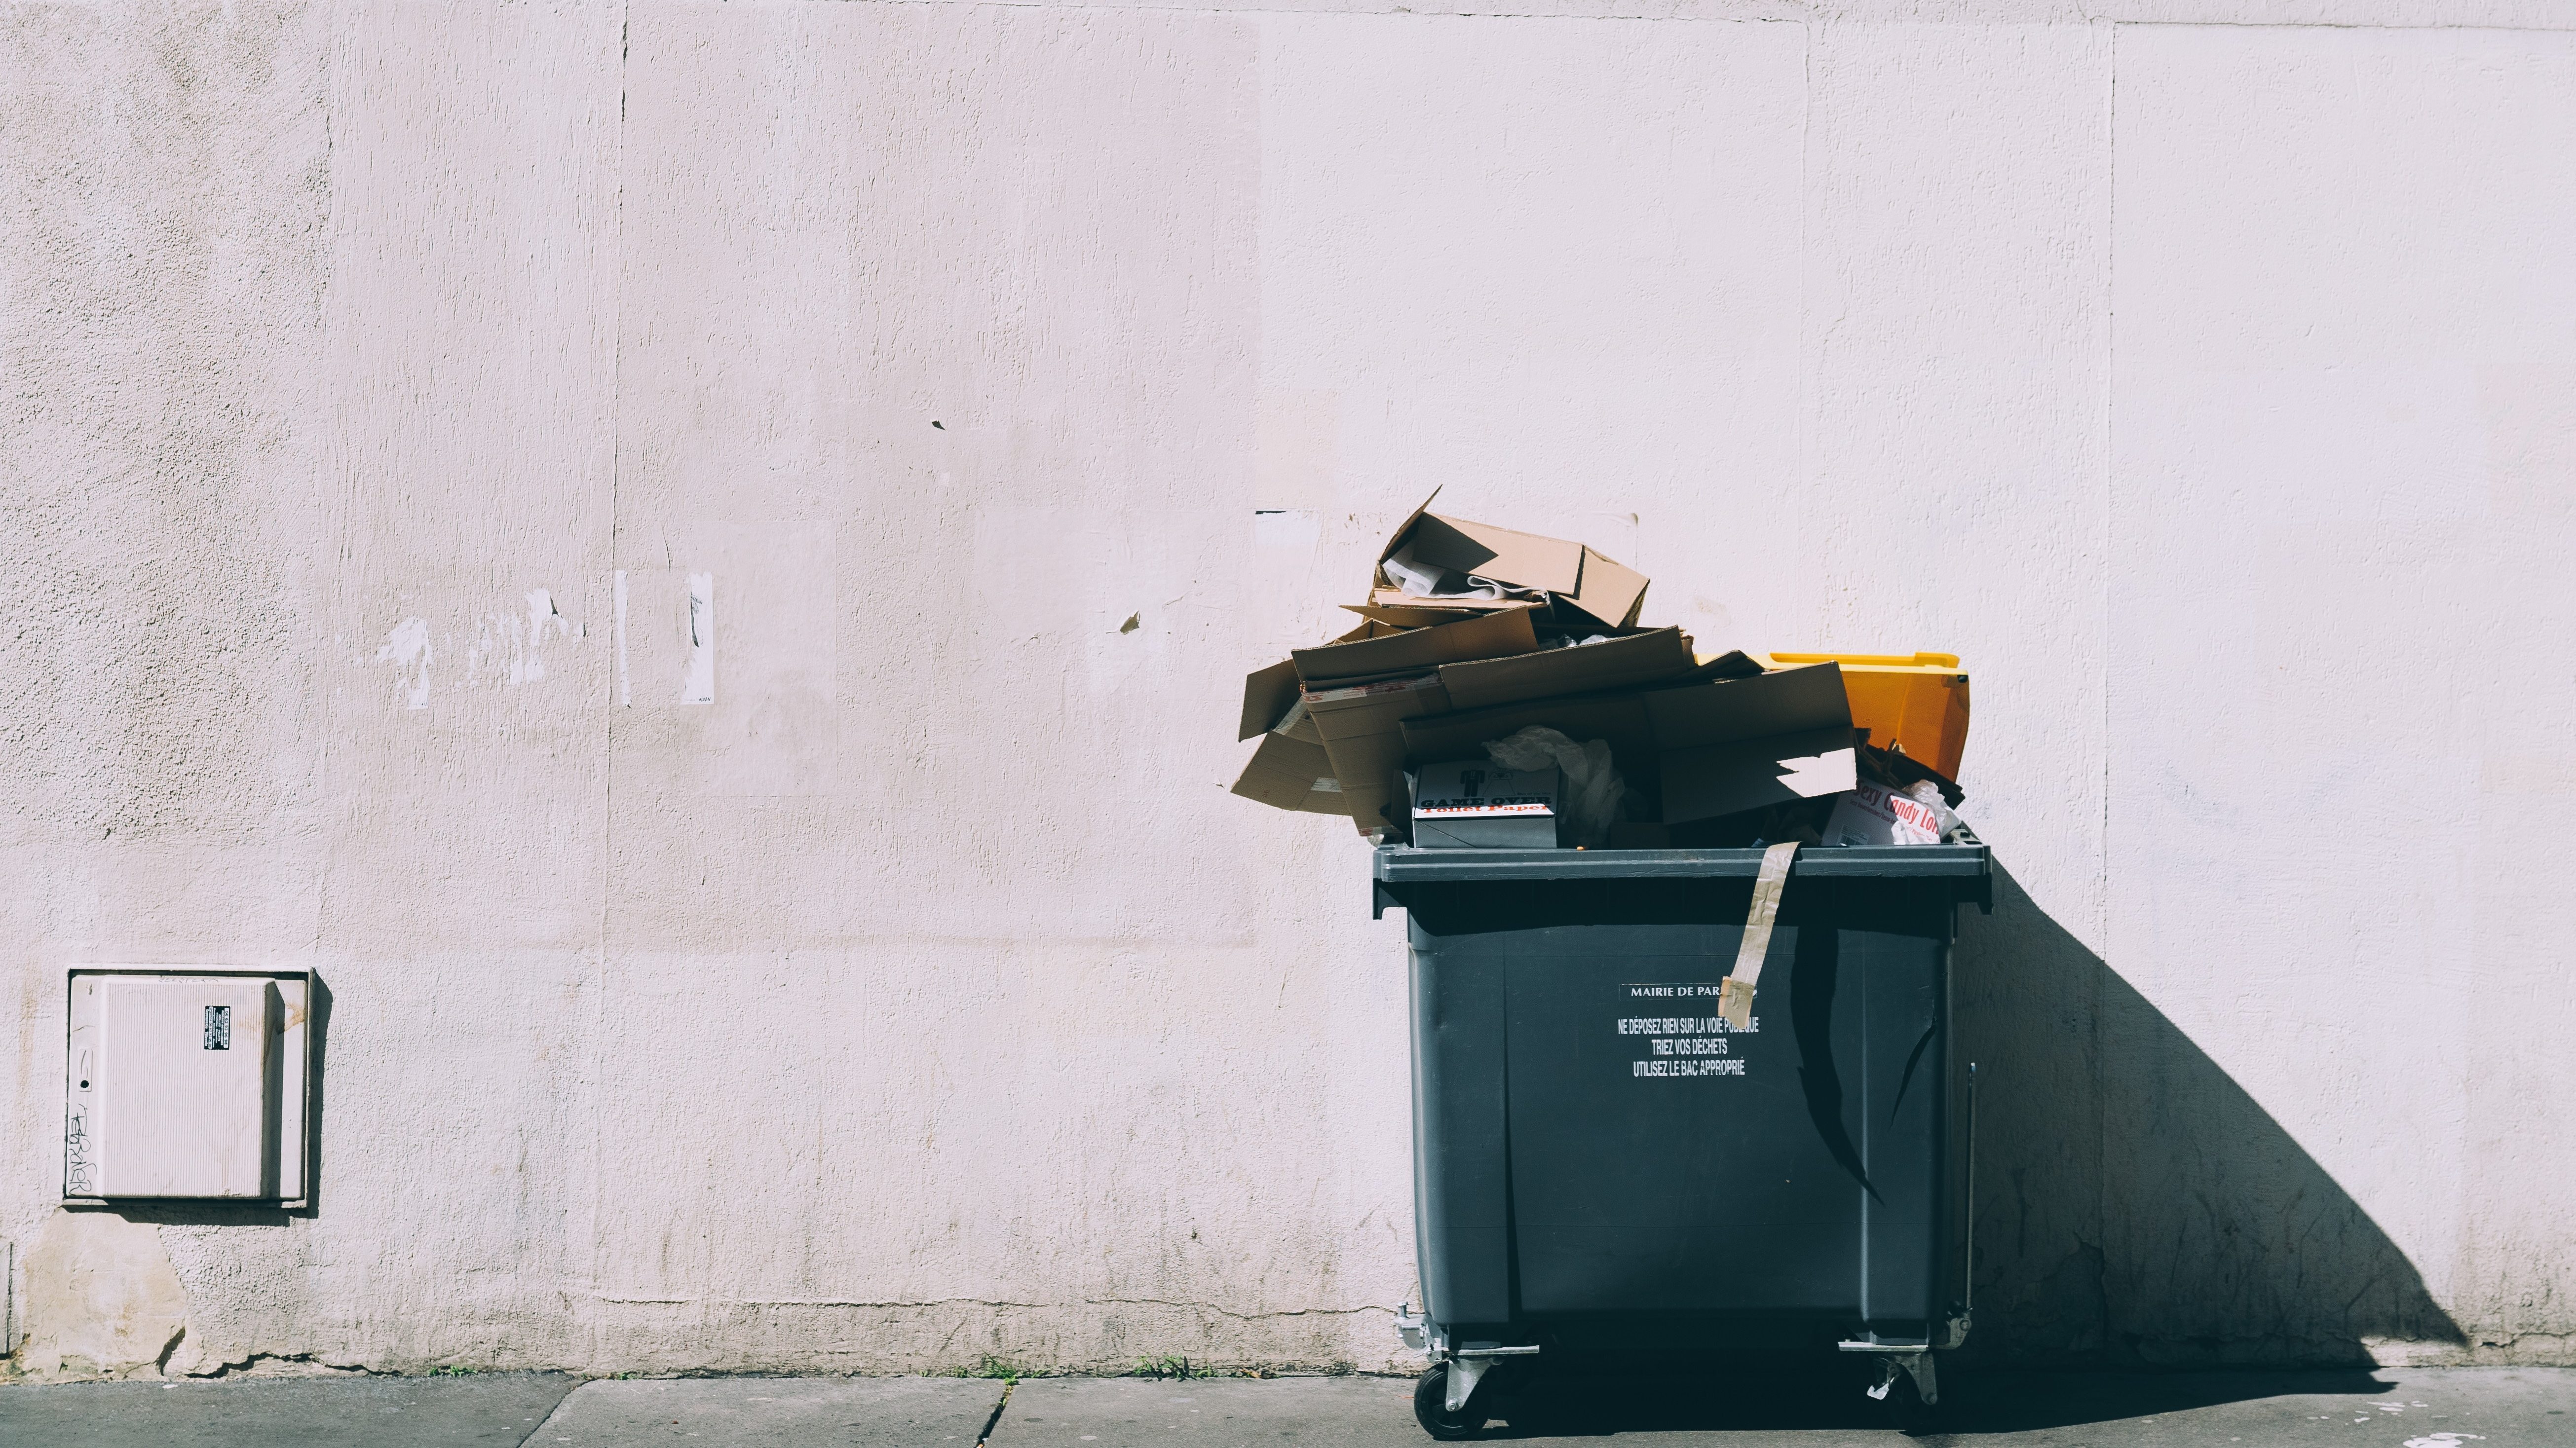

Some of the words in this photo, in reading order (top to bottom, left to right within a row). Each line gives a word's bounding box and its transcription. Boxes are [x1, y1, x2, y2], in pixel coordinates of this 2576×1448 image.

[1421, 798, 1484, 808] GAME
[1491, 796, 1553, 805] OVER
[1853, 779, 1883, 806] Sexy
[1884, 792, 1919, 824] Candy
[1631, 987, 1674, 997] MAIRIE
[1677, 987, 1694, 996] DE
[1698, 987, 1722, 996] PAR
[1618, 1019, 1628, 1035] NE
[1629, 1015, 1662, 1034] DÉPOSEZ
[1663, 1018, 1679, 1034] RIEN
[1680, 1018, 1694, 1033] SUR
[1696, 1017, 1705, 1033] LA
[1706, 1017, 1723, 1033] VOIE
[1651, 1039, 1673, 1055] TRIEZ
[1675, 1039, 1691, 1055] VOS
[1692, 1035, 1727, 1054] DÉCHETS
[1633, 1061, 1668, 1077] UTILISEZ
[1669, 1060, 1680, 1076] LE
[1681, 1060, 1698, 1076] BAC
[1700, 1056, 1745, 1076] APPROPRIÉ
